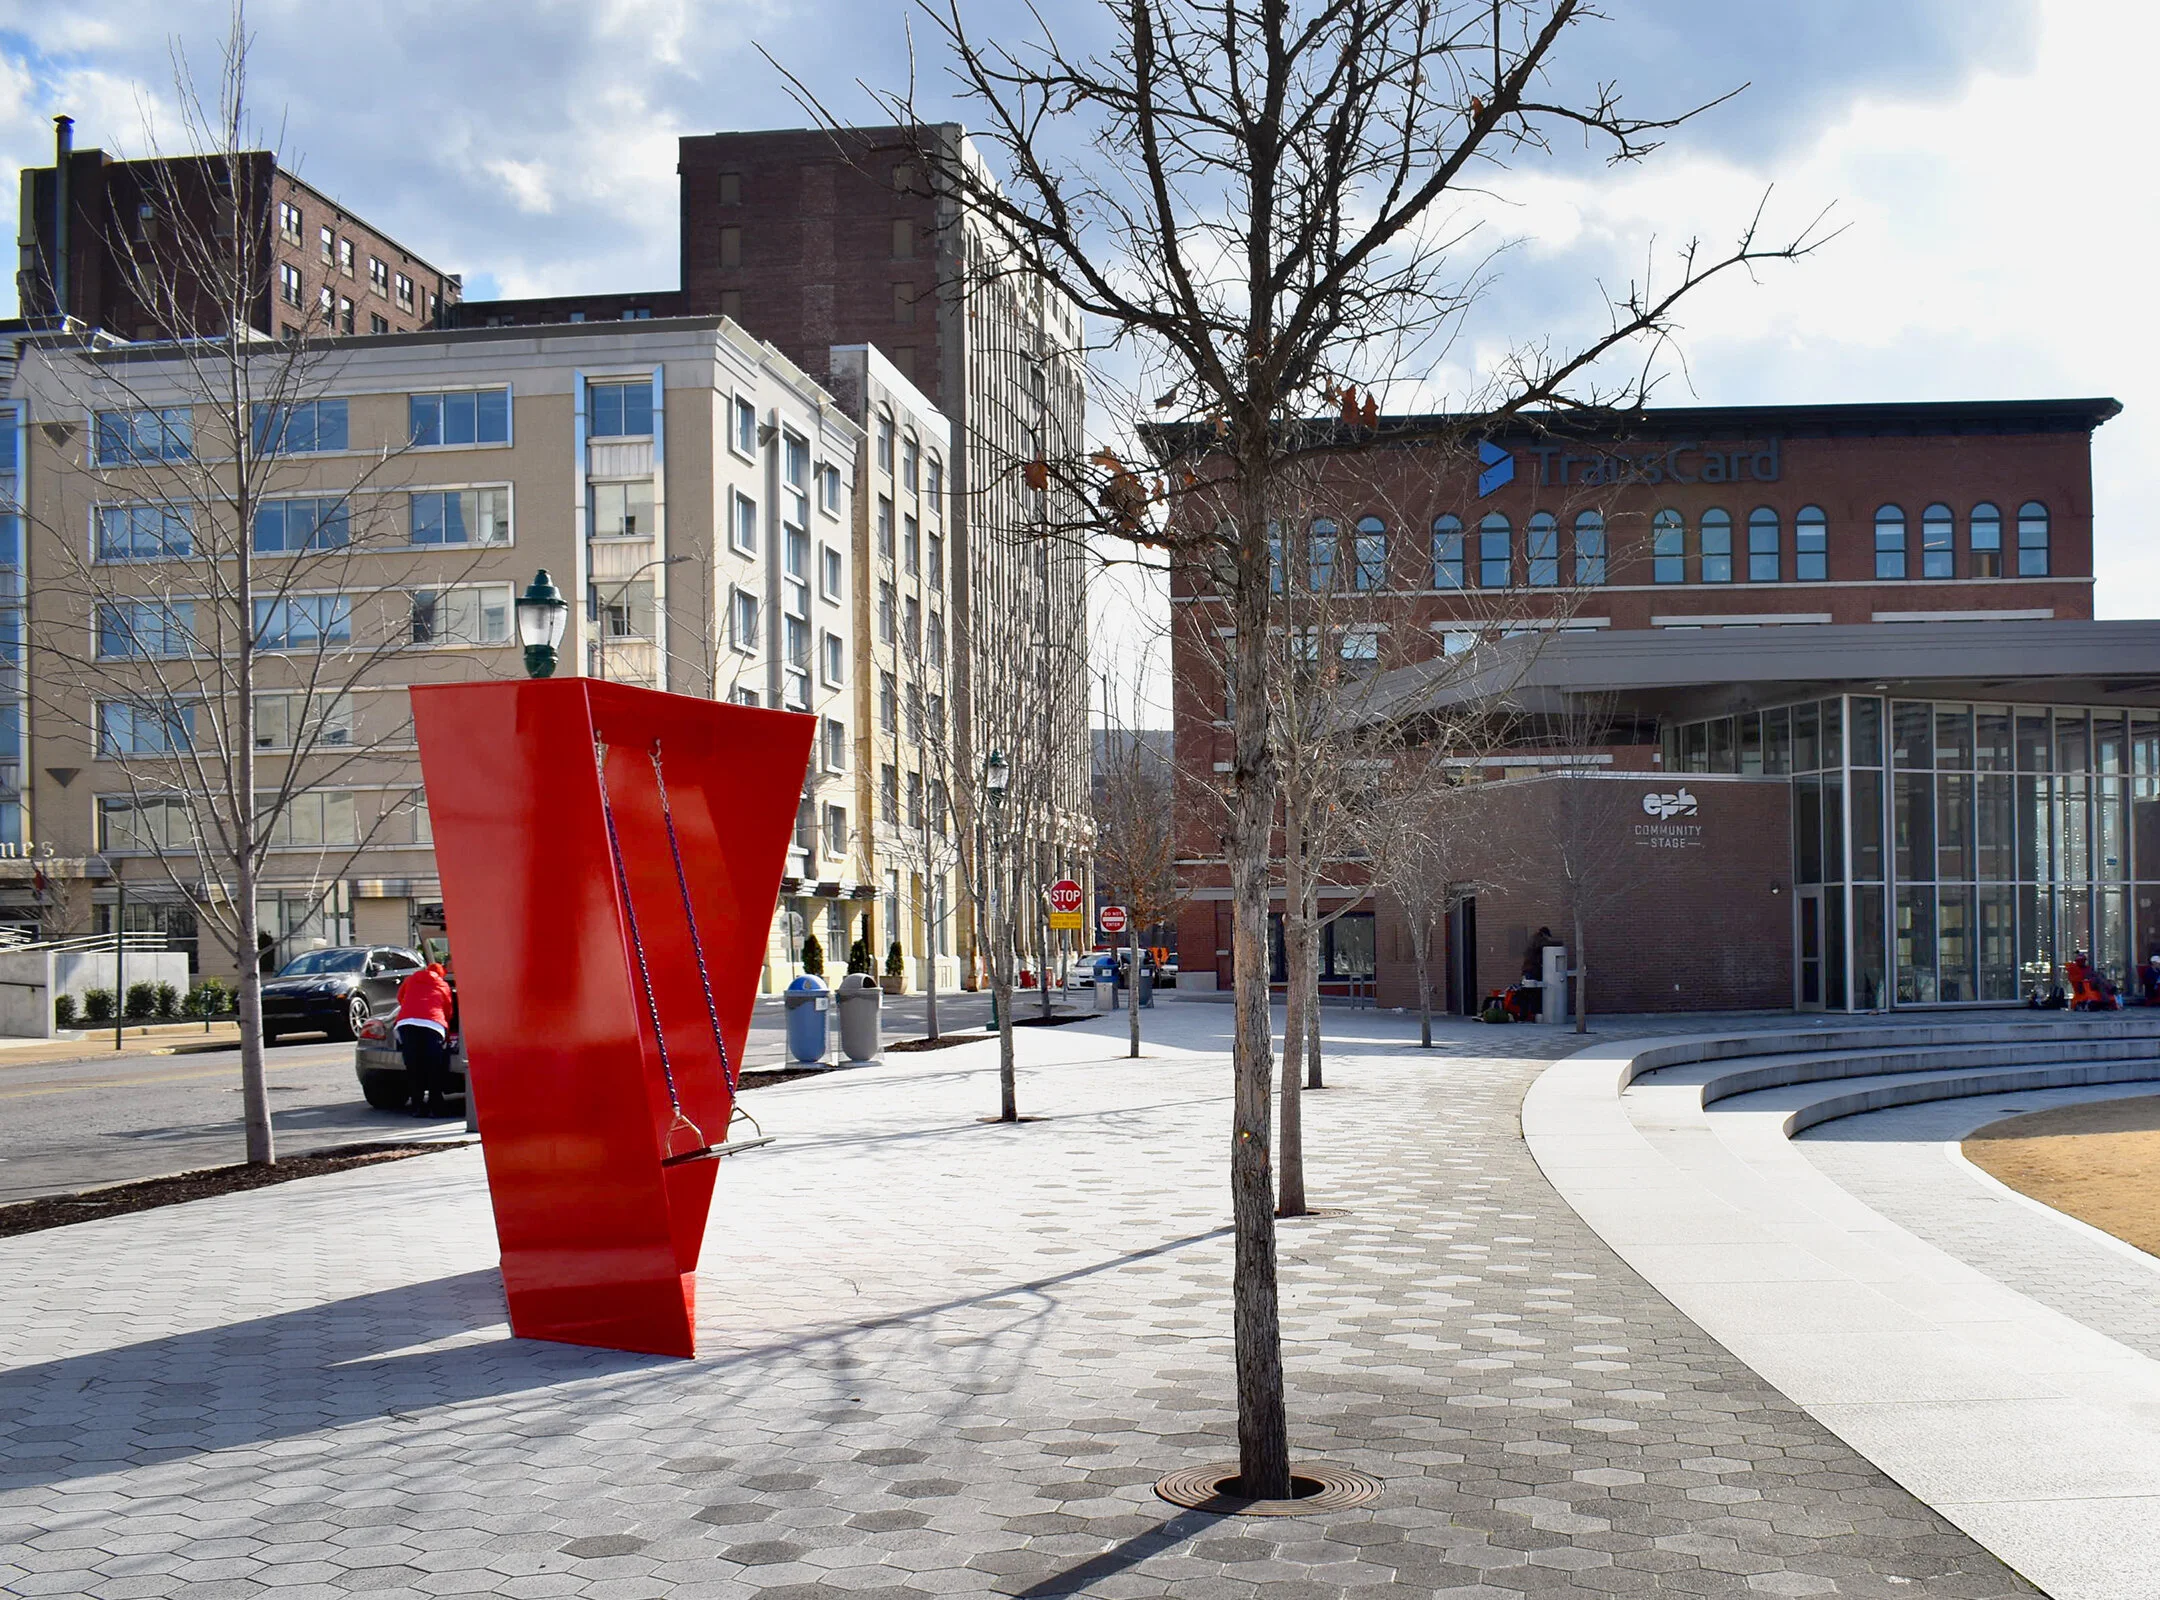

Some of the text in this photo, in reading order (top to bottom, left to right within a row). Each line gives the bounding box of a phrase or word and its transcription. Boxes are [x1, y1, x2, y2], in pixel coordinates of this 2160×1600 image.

[1529, 437, 1782, 486] TransCard
[1635, 825, 1702, 836] COMMUNITY
[1651, 838, 1686, 848] STAGE
[1052, 889, 1081, 902] STOP
